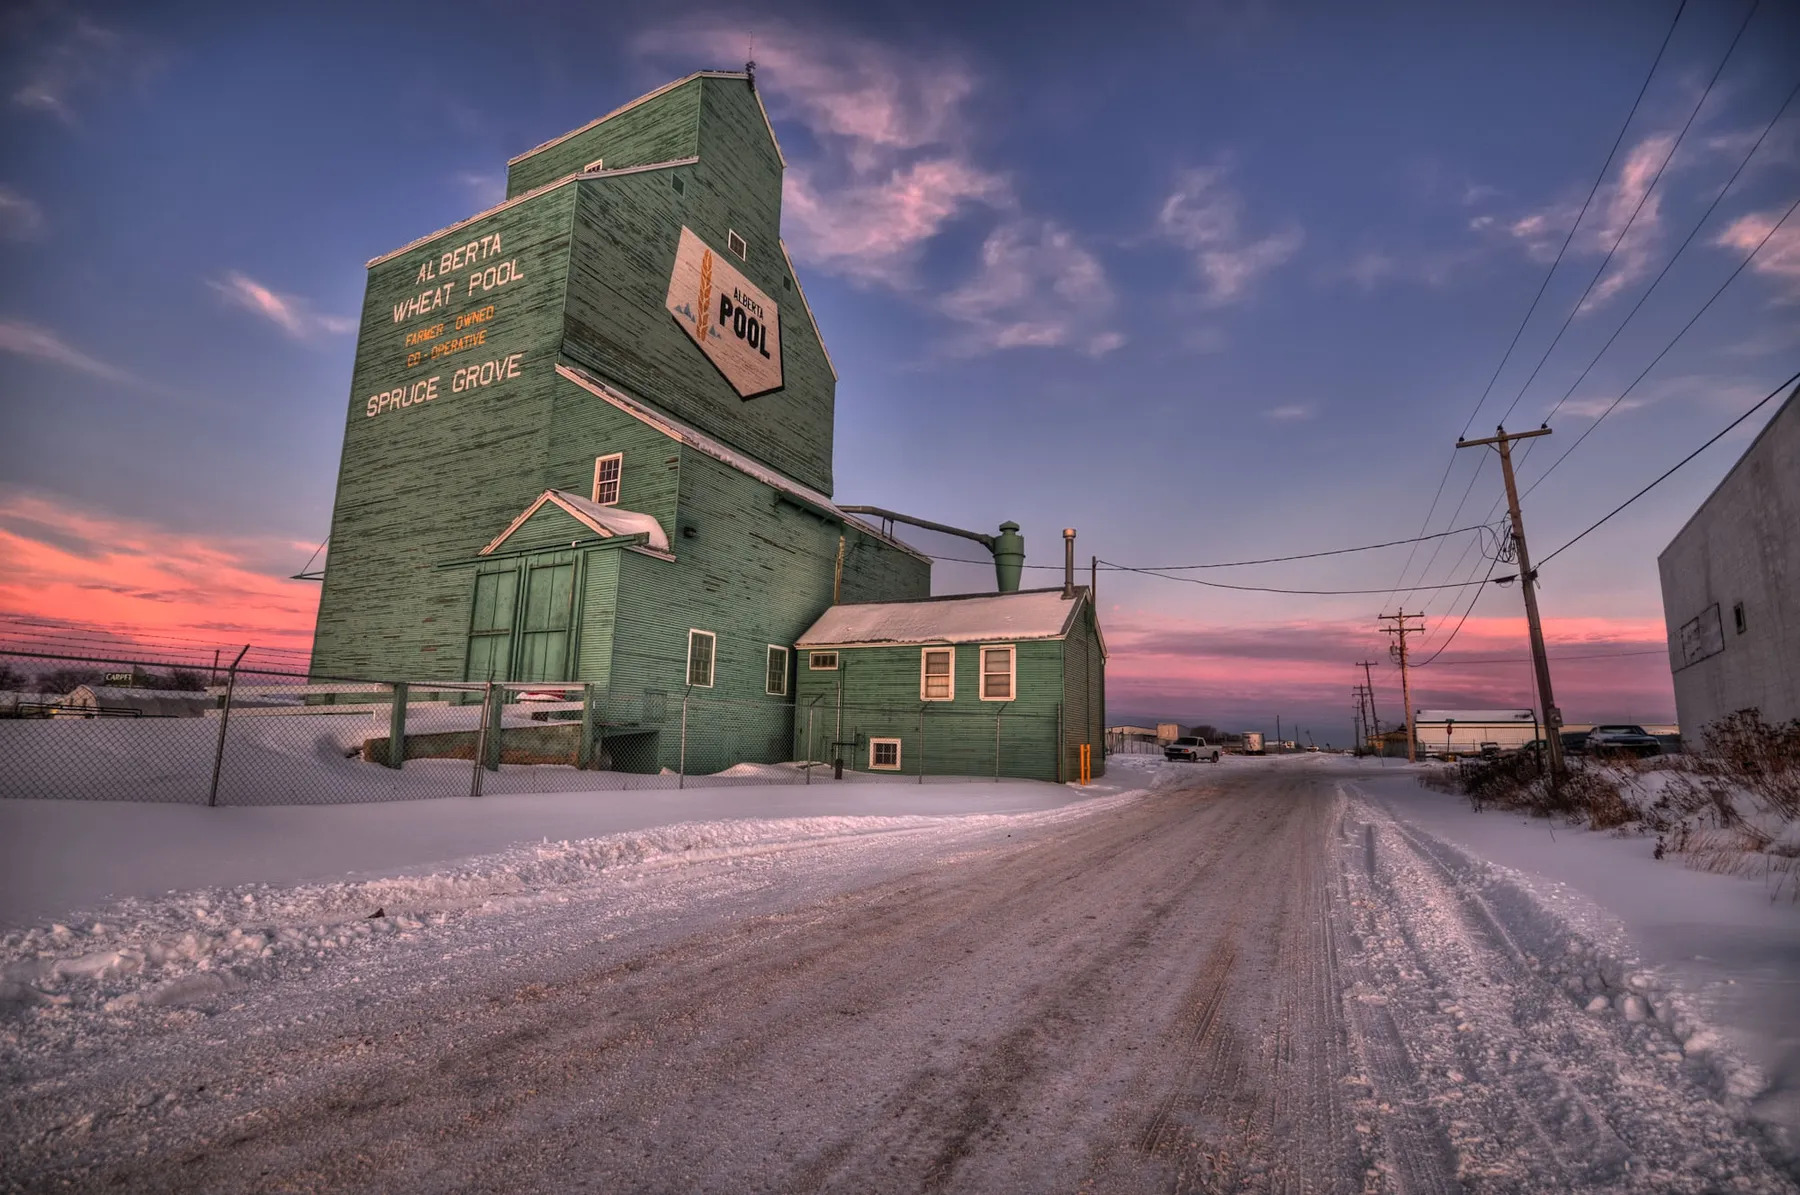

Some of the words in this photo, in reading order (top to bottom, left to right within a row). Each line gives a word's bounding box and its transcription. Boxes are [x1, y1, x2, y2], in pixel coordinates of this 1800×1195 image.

[415, 233, 502, 285] ALBERTA
[393, 282, 455, 323] WHEAT
[468, 259, 524, 297] POOL
[733, 286, 764, 321] ALBERTA
[405, 323, 445, 347] FARMER
[455, 305, 495, 331] OWNED
[719, 292, 770, 360] POOL
[366, 376, 440, 417] SPRUCE
[452, 353, 523, 393] GROVE
